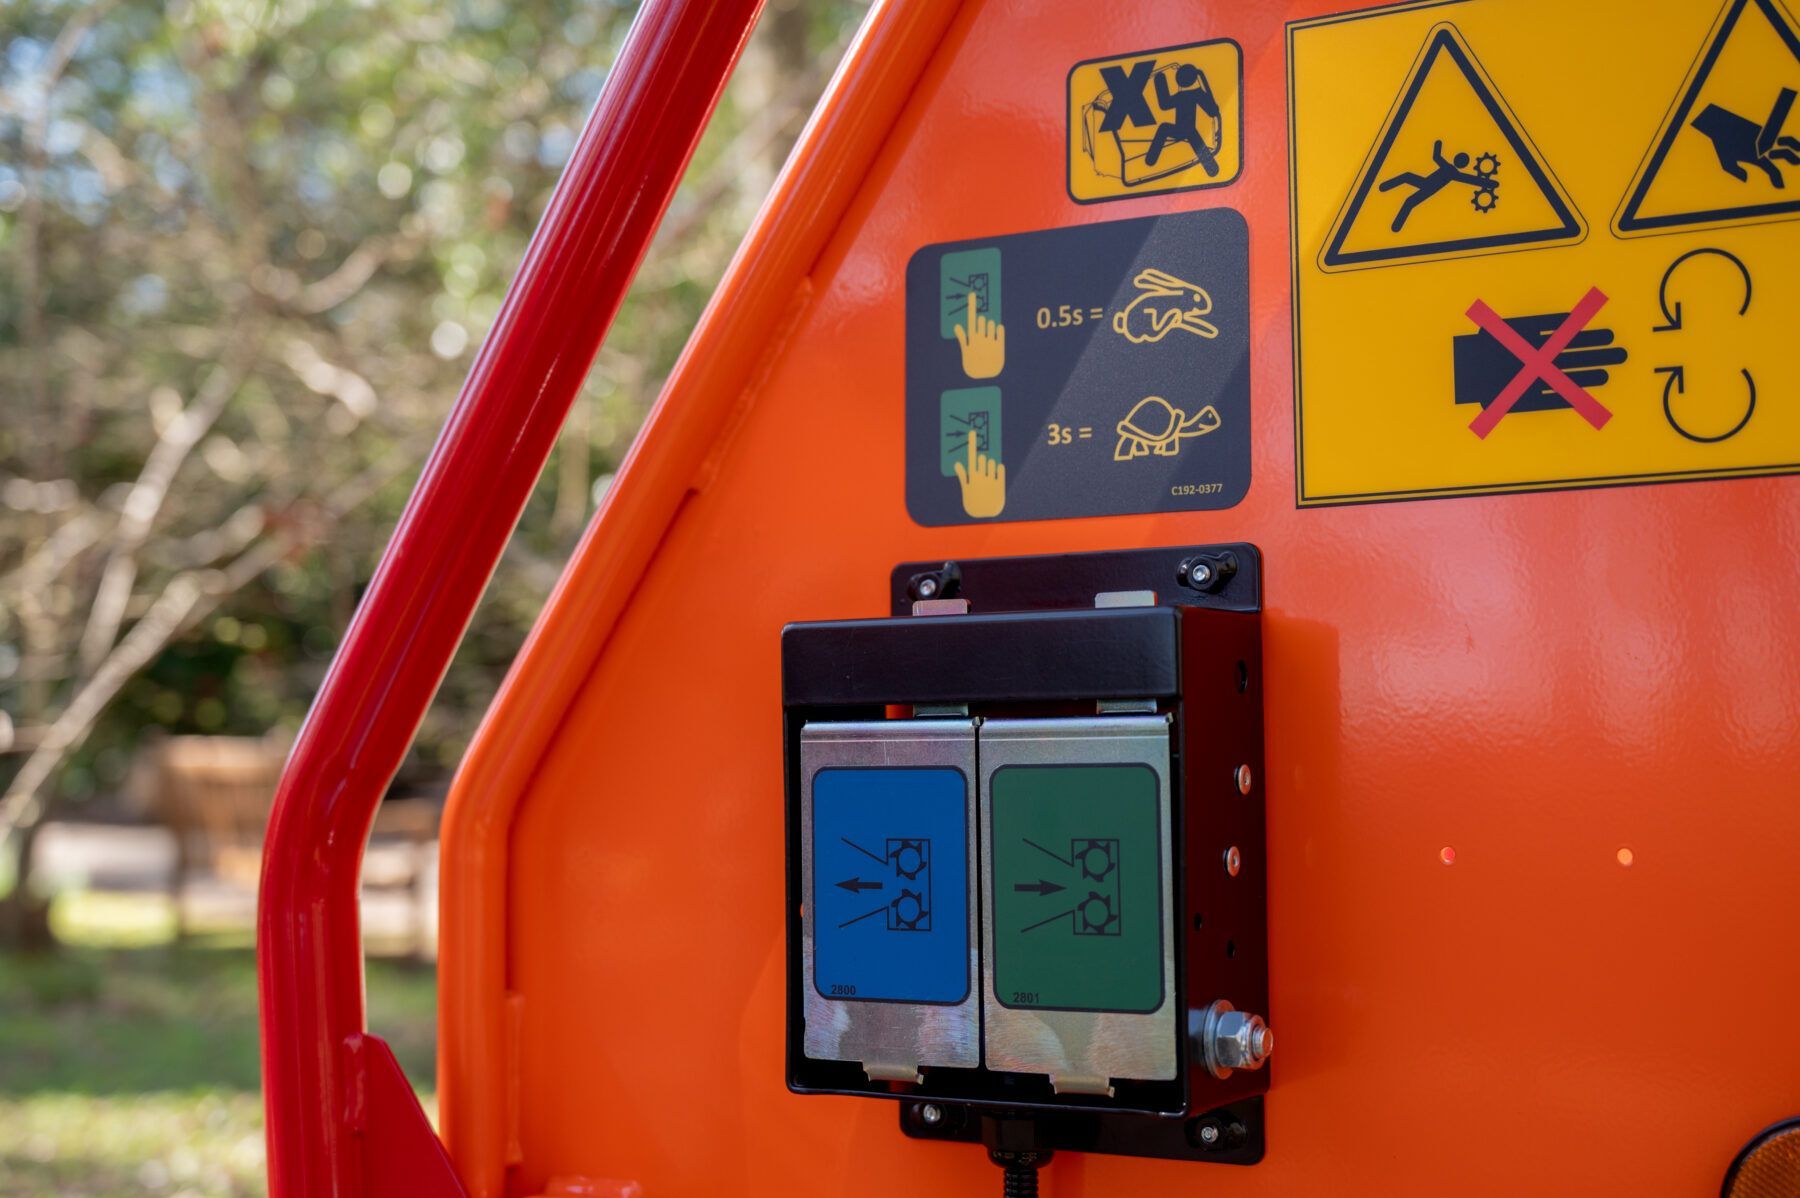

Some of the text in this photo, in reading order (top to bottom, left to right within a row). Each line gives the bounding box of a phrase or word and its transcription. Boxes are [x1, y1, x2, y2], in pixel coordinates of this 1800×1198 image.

[1036, 304, 1084, 329] 0.5s
[1047, 423, 1072, 446] 3s
[1171, 483, 1223, 496] C192-0377
[831, 984, 856, 996] 2800
[1013, 991, 1040, 1005] 2801
